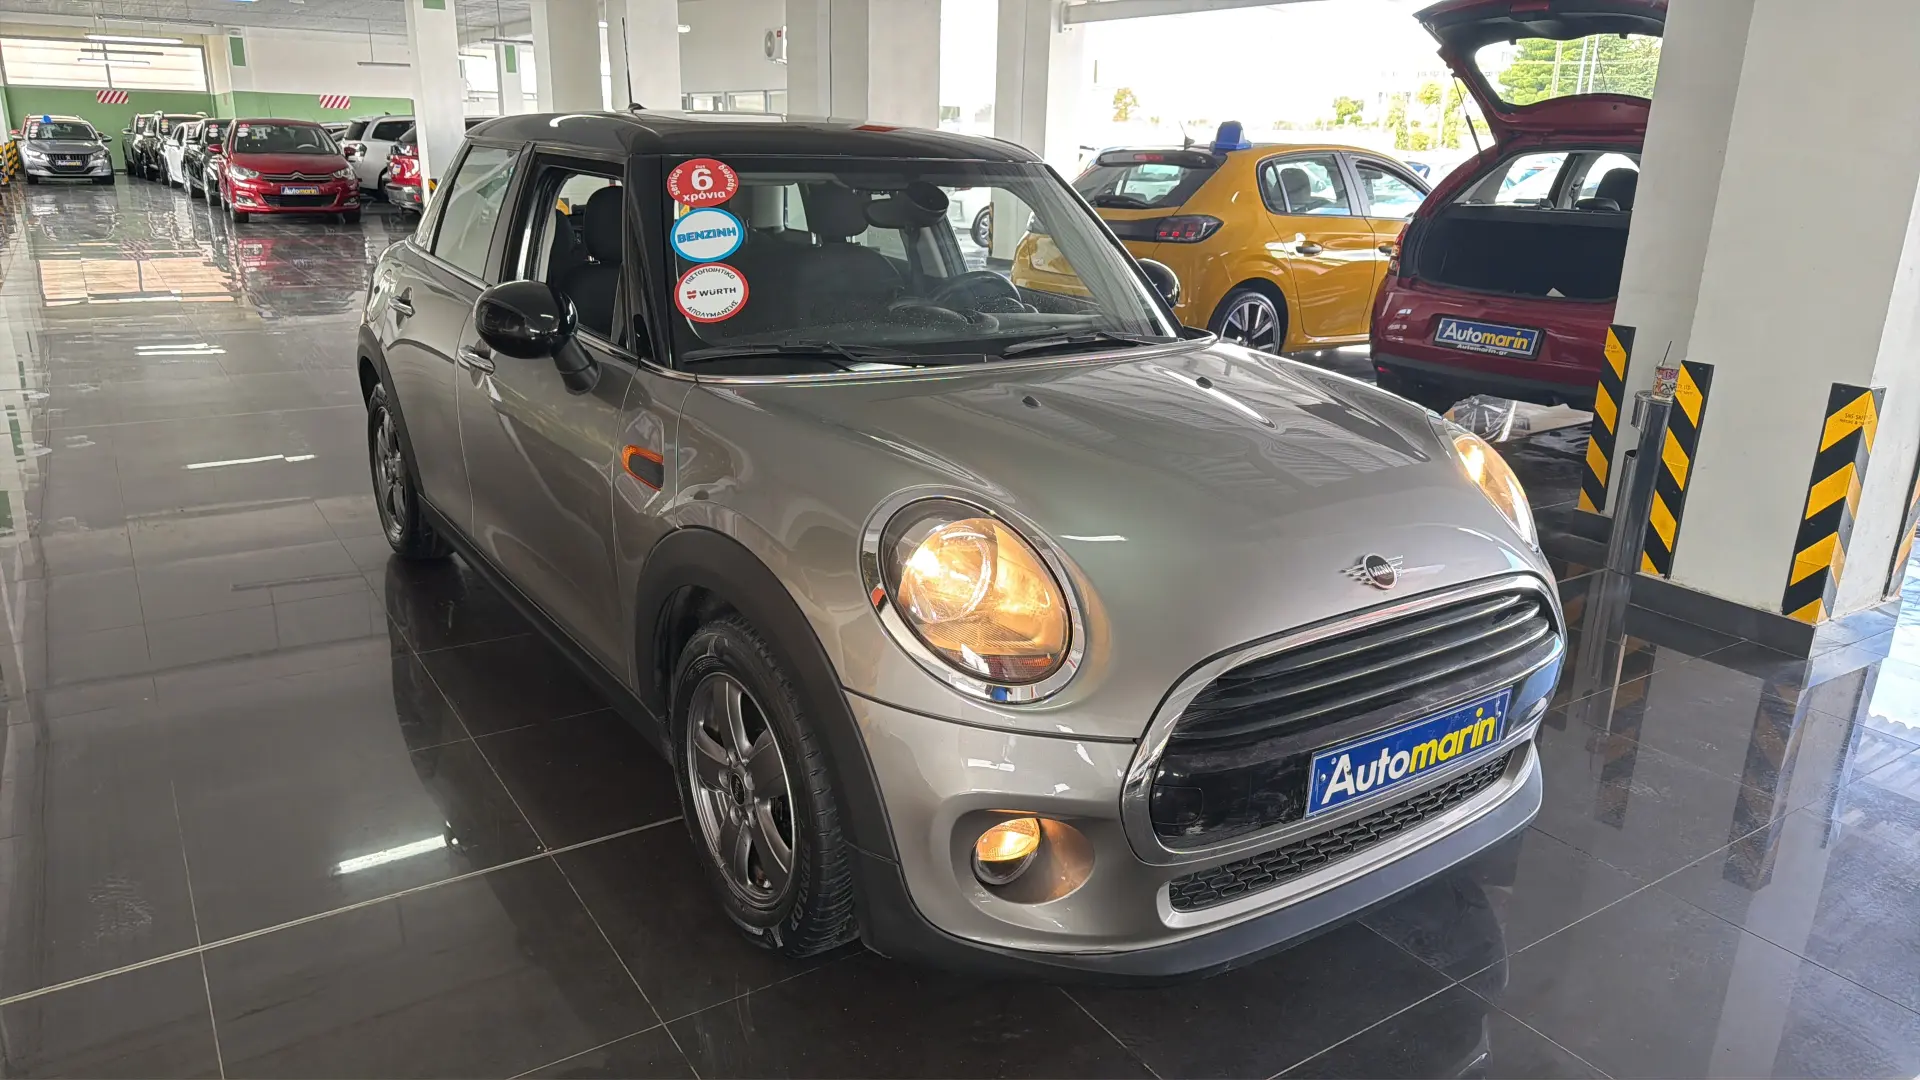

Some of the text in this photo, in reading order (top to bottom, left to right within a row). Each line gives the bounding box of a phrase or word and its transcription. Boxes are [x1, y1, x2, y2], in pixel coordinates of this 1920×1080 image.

[670, 168, 683, 196] service
[691, 168, 714, 191] 6
[682, 191, 726, 203] χρόνια
[699, 287, 737, 298] WÜRTH
[1442, 322, 1529, 350] Automarin
[1456, 343, 1509, 356] Automarin.gr
[1320, 707, 1496, 805] Automarin
